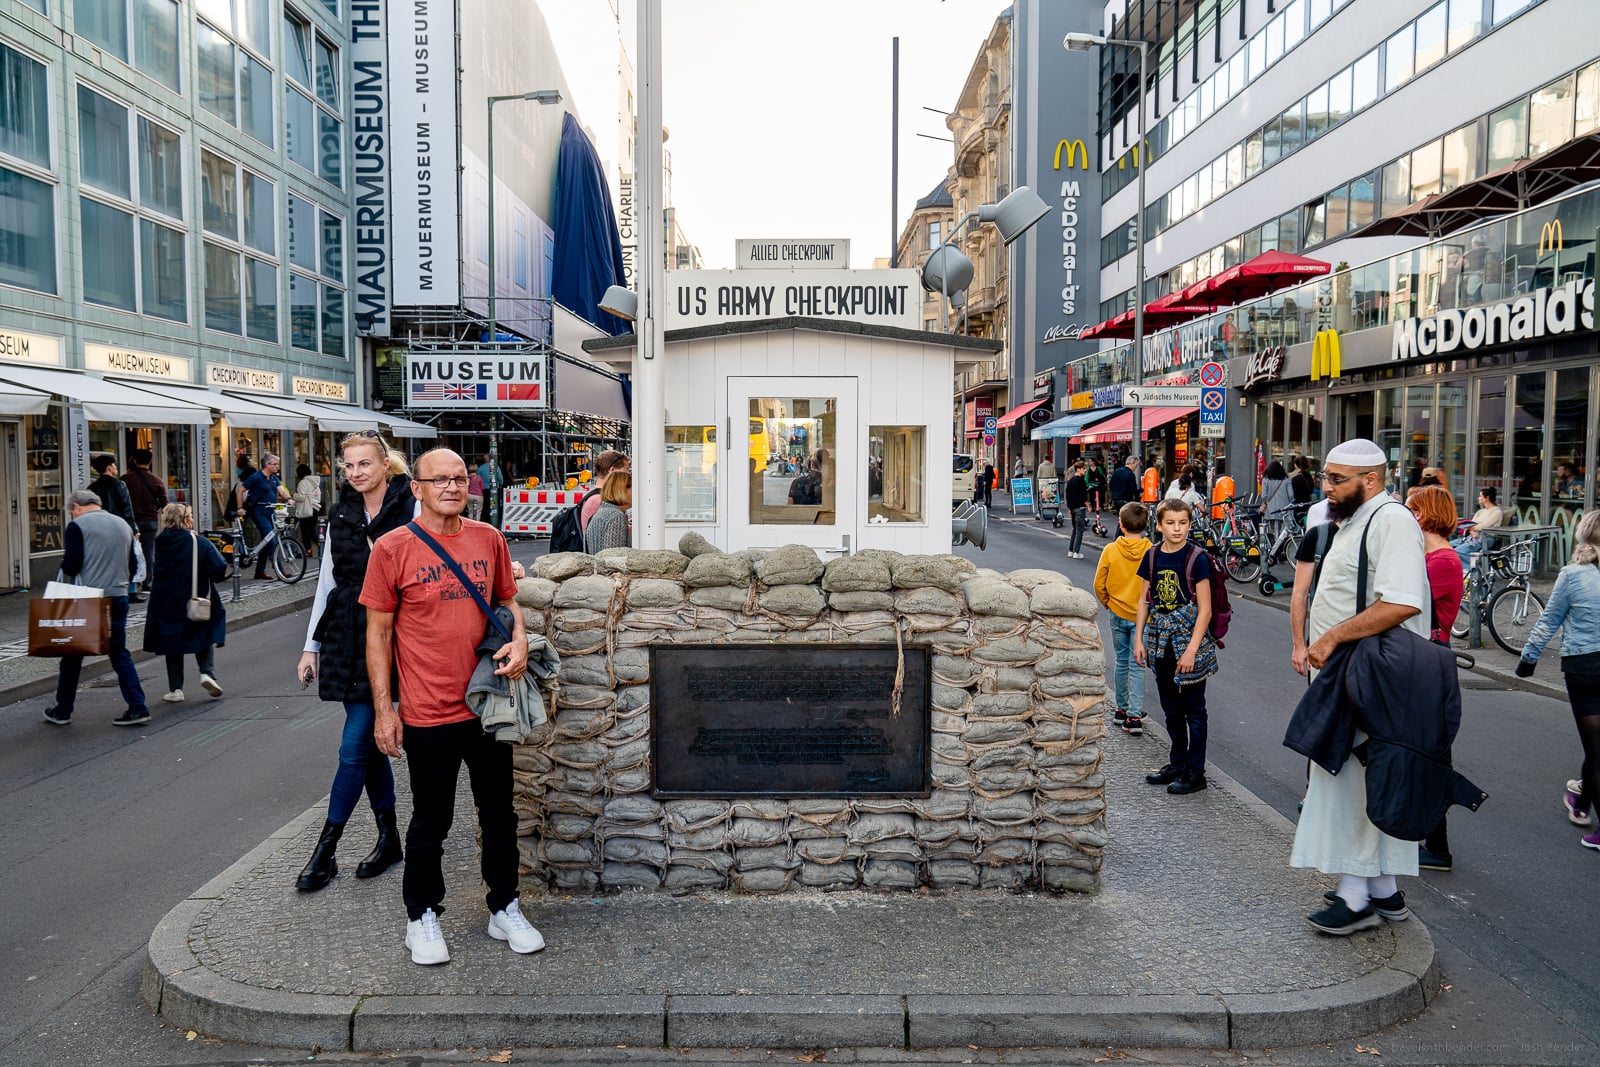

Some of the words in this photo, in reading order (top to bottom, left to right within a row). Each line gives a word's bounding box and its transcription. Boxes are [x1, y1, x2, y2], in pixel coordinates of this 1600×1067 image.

[352, 0, 380, 43] TH
[414, 1, 430, 93] MUSEUM
[353, 61, 386, 324] MAUERMUSEUM
[417, 122, 433, 290] MAUERMUSEUM
[620, 178, 632, 239] CHARLIE
[750, 244, 778, 261] ALLIED
[782, 243, 835, 261] CHECKPOINT
[1060, 180, 1080, 315] McDonald's
[718, 286, 775, 316] ARMY
[785, 286, 908, 316] CHECKPOINT
[1391, 278, 1595, 360] McDonald's
[1043, 323, 1089, 342] McCaf
[1142, 333, 1172, 373] SNACKS
[1173, 329, 1181, 366] &
[1181, 319, 1215, 364] COFFEE
[108, 351, 171, 376] MAUERMUSEUM
[212, 367, 250, 386] CHECKPOINT
[251, 372, 275, 390] CHARLIE
[411, 361, 541, 381] MUSEUM
[1244, 345, 1283, 386] McCafé
[296, 379, 325, 395] CHECKPOINT
[325, 384, 343, 398] CHARLIE
[1143, 392, 1172, 401] Jüdisches
[1174, 393, 1199, 401] Museum
[1202, 412, 1223, 421] TAXI
[200, 429, 208, 506] MUSEUMTICKETS
